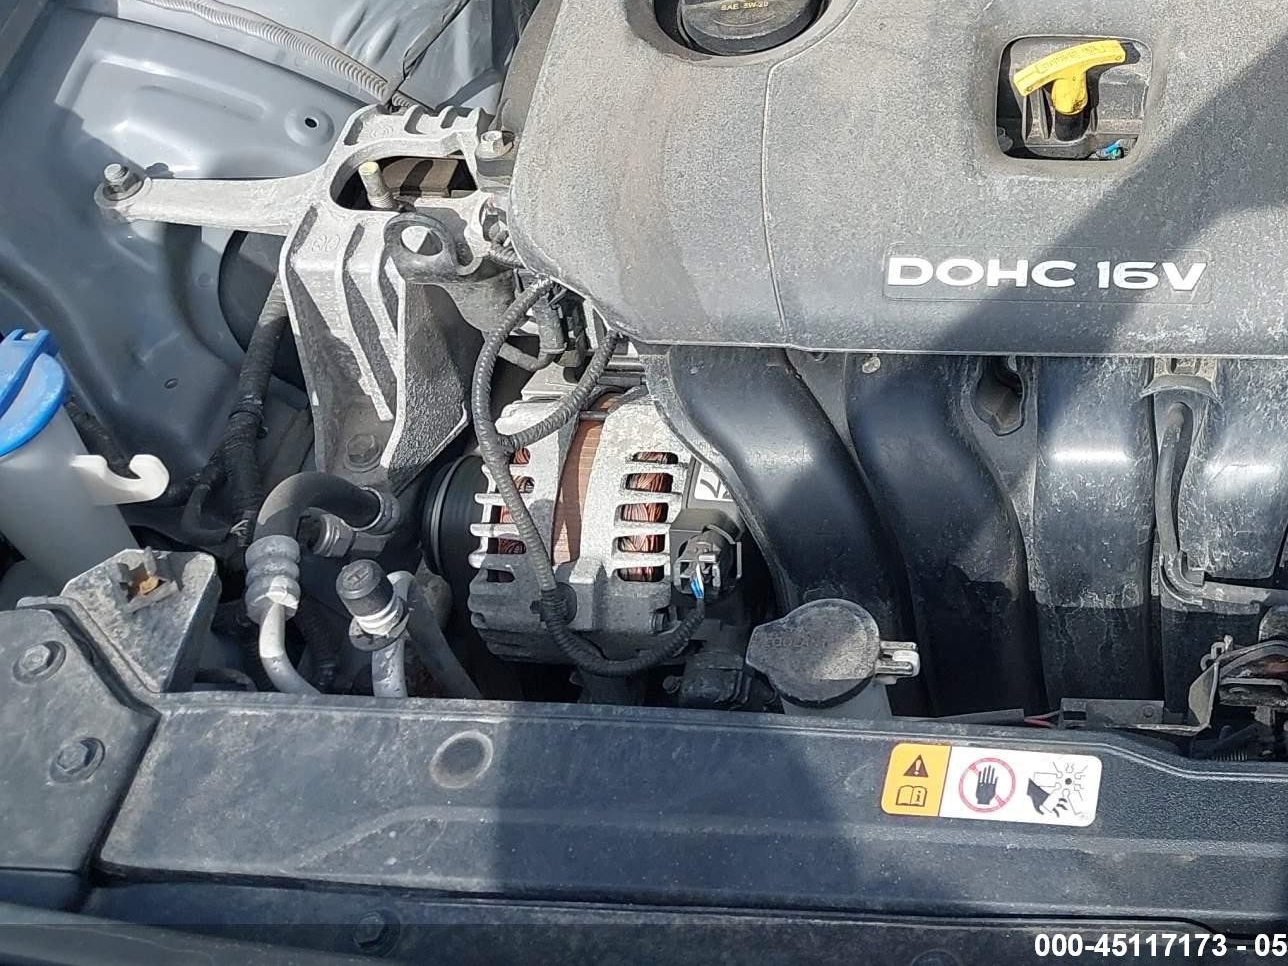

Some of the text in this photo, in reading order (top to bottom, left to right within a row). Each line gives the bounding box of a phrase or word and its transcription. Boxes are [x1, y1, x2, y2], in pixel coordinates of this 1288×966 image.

[721, 1, 769, 11] SAE 5W-20
[887, 257, 1208, 292] DOHC 16V
